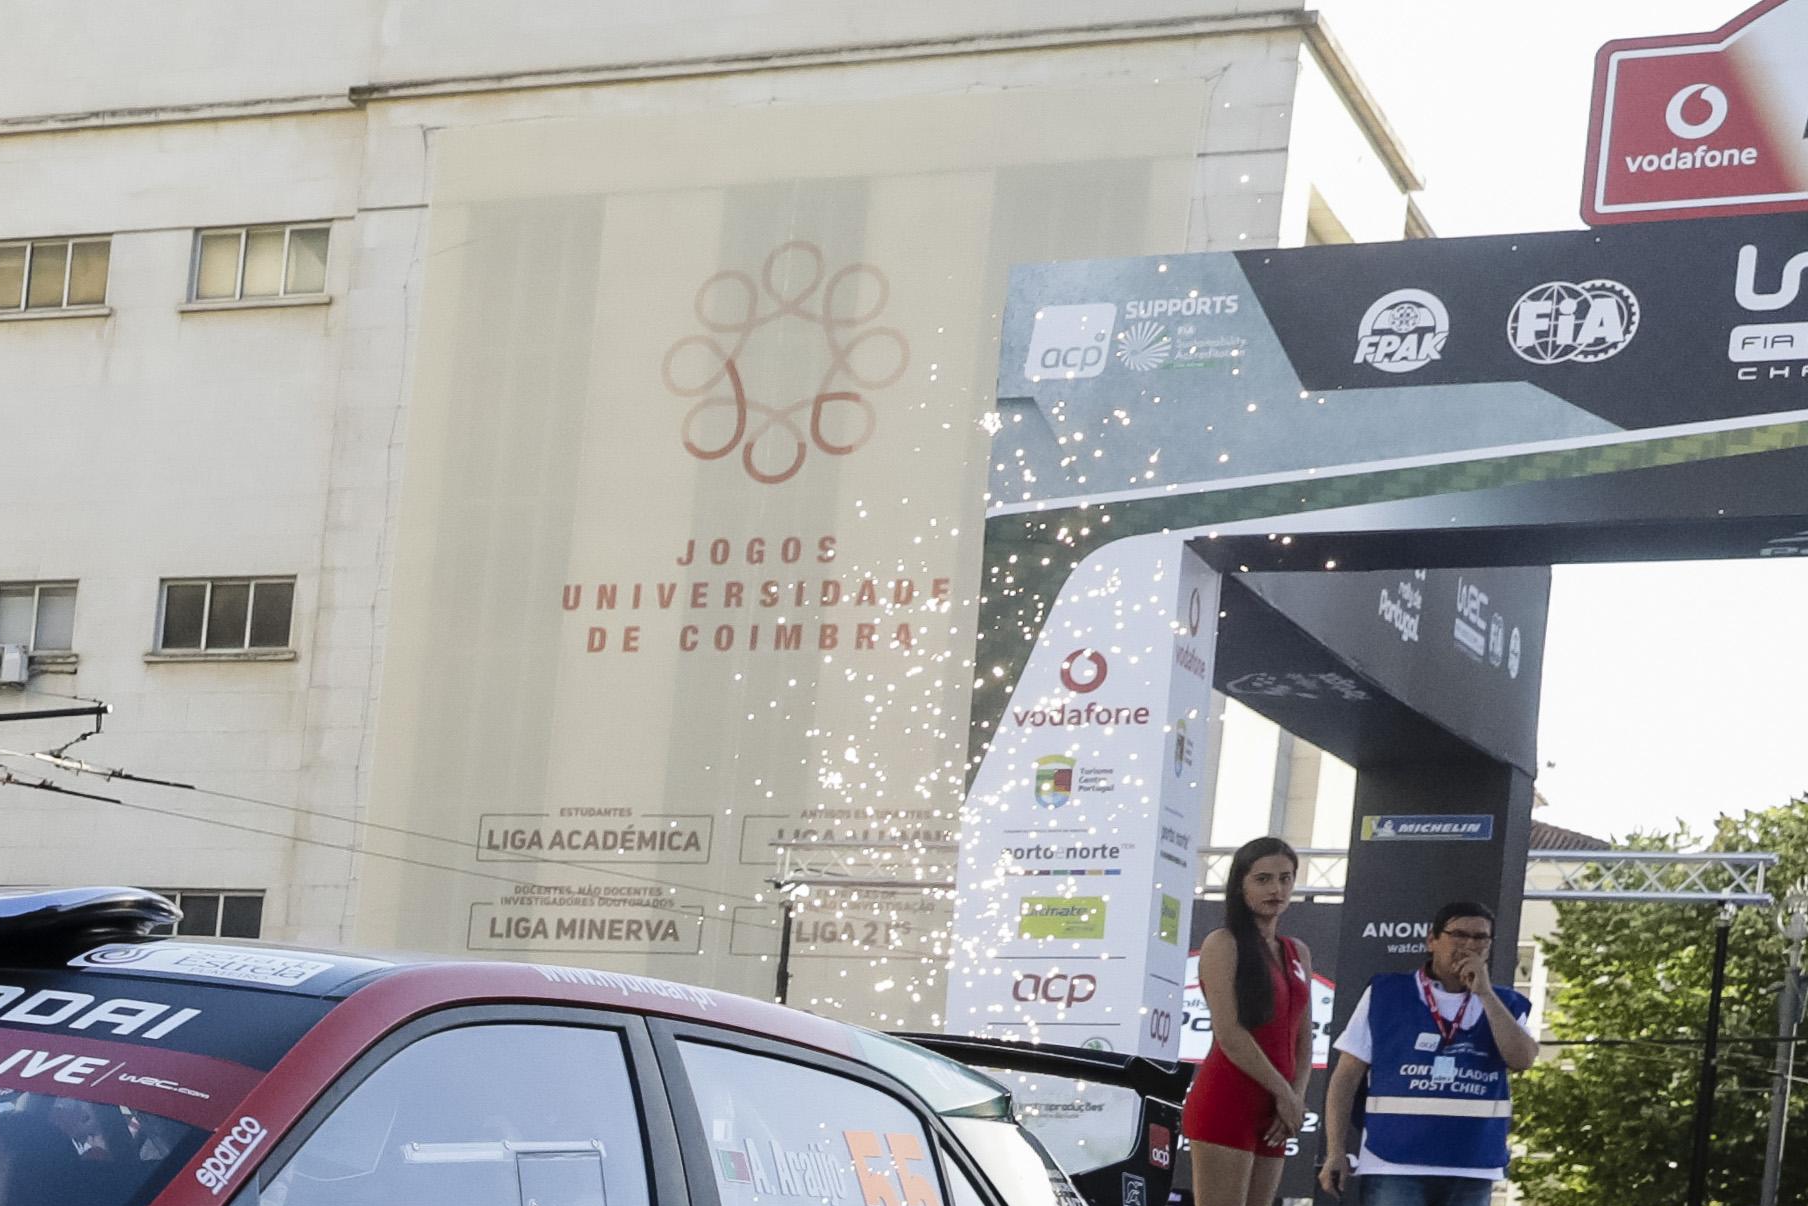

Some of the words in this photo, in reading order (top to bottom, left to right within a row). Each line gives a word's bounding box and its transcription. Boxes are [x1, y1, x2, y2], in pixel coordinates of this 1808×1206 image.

[1626, 145, 1758, 173] vodafone
[1125, 295, 1240, 320] SUPPORTS
[1516, 297, 1626, 347] FIA
[1353, 330, 1449, 365] FPAK
[1741, 334, 1794, 350] FIA
[1041, 345, 1103, 371] acp
[676, 535, 838, 566] JOGOS
[562, 578, 951, 611] UNIVERSIDADE
[1378, 588, 1419, 642] Portugal
[587, 626, 641, 653] DE
[679, 623, 914, 653] COIMBRA
[1014, 702, 1150, 727] vodafone
[560, 807, 632, 818] ESTUDANTES
[487, 829, 543, 851] LIGA
[548, 824, 702, 852] ACADÉMICA
[1398, 822, 1481, 833] MICHELIN
[490, 917, 548, 940] LIGA
[555, 919, 680, 942] MINERVA
[795, 920, 855, 944] LIGA
[1011, 973, 1097, 1008] acp
[1150, 1008, 1171, 1047] acp
[1409, 1078, 1447, 1091] POST
[1451, 1081, 1487, 1096] CHIEF
[194, 1114, 264, 1190] sparco
